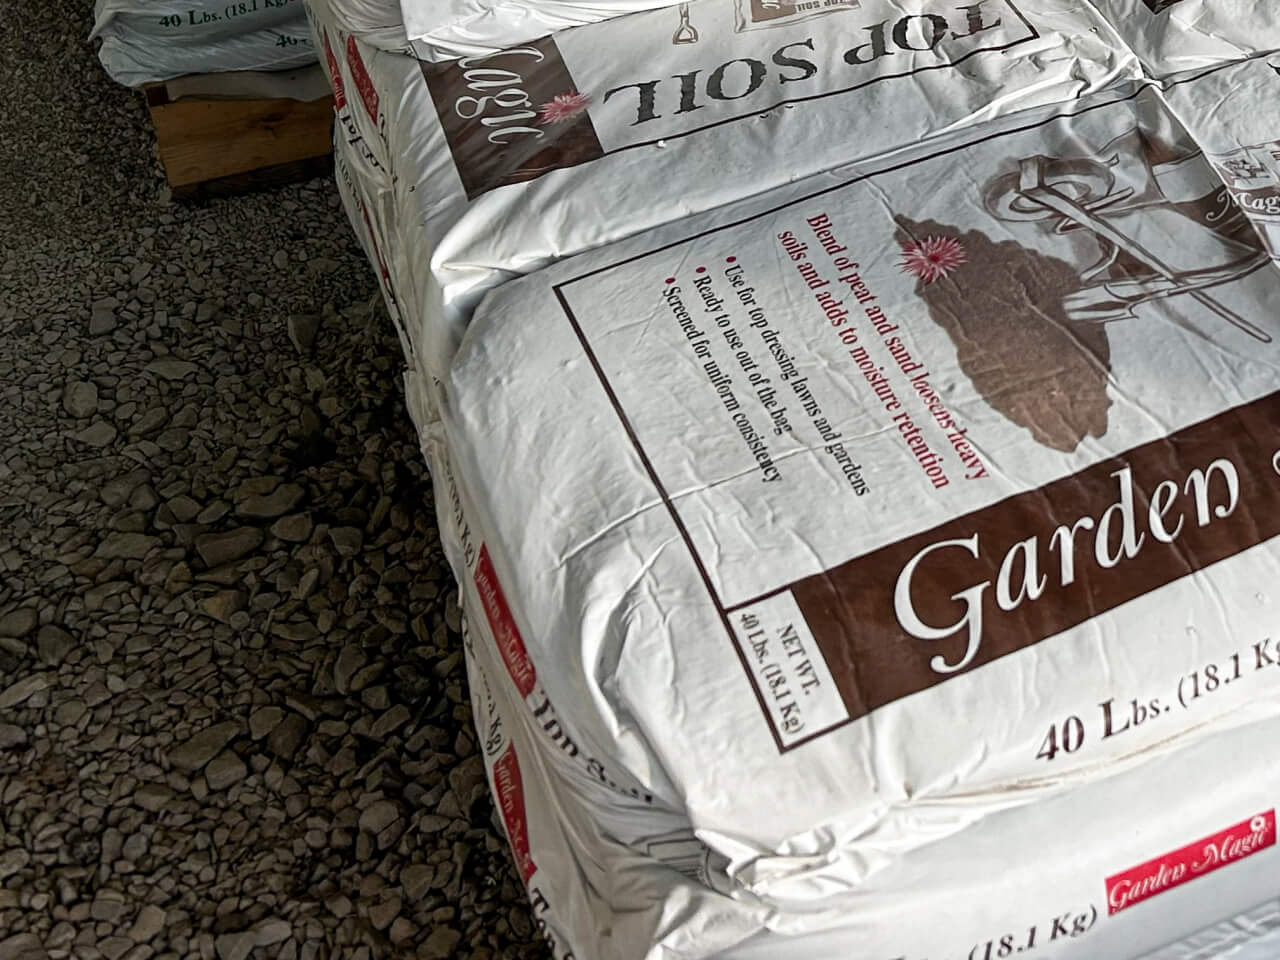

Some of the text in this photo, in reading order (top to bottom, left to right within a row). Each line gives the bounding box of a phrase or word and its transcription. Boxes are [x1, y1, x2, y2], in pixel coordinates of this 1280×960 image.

[158, 14, 182, 28] 40
[189, 9, 222, 26] Lbs.
[224, 0, 259, 21] (18.1
[604, 39, 820, 127] SOIL
[662, 284, 783, 486] Screened for uniform consistency
[692, 274, 794, 437] Ready to use out of the bag
[723, 264, 871, 497] Use for top dressing lawns and gardens
[776, 229, 951, 490] soils and adds to moisture retention
[806, 212, 992, 482] Blend of peat and sand loosens heavy
[893, 458, 1240, 674] Garden
[748, 629, 806, 735] Lbs. (18.1 Kg)
[776, 622, 820, 696] NET WT.
[1035, 647, 1243, 762] 40 Lbs. (18.1
[1048, 905, 1098, 943] Kg)
[1110, 830, 1267, 912] Garden Magic
